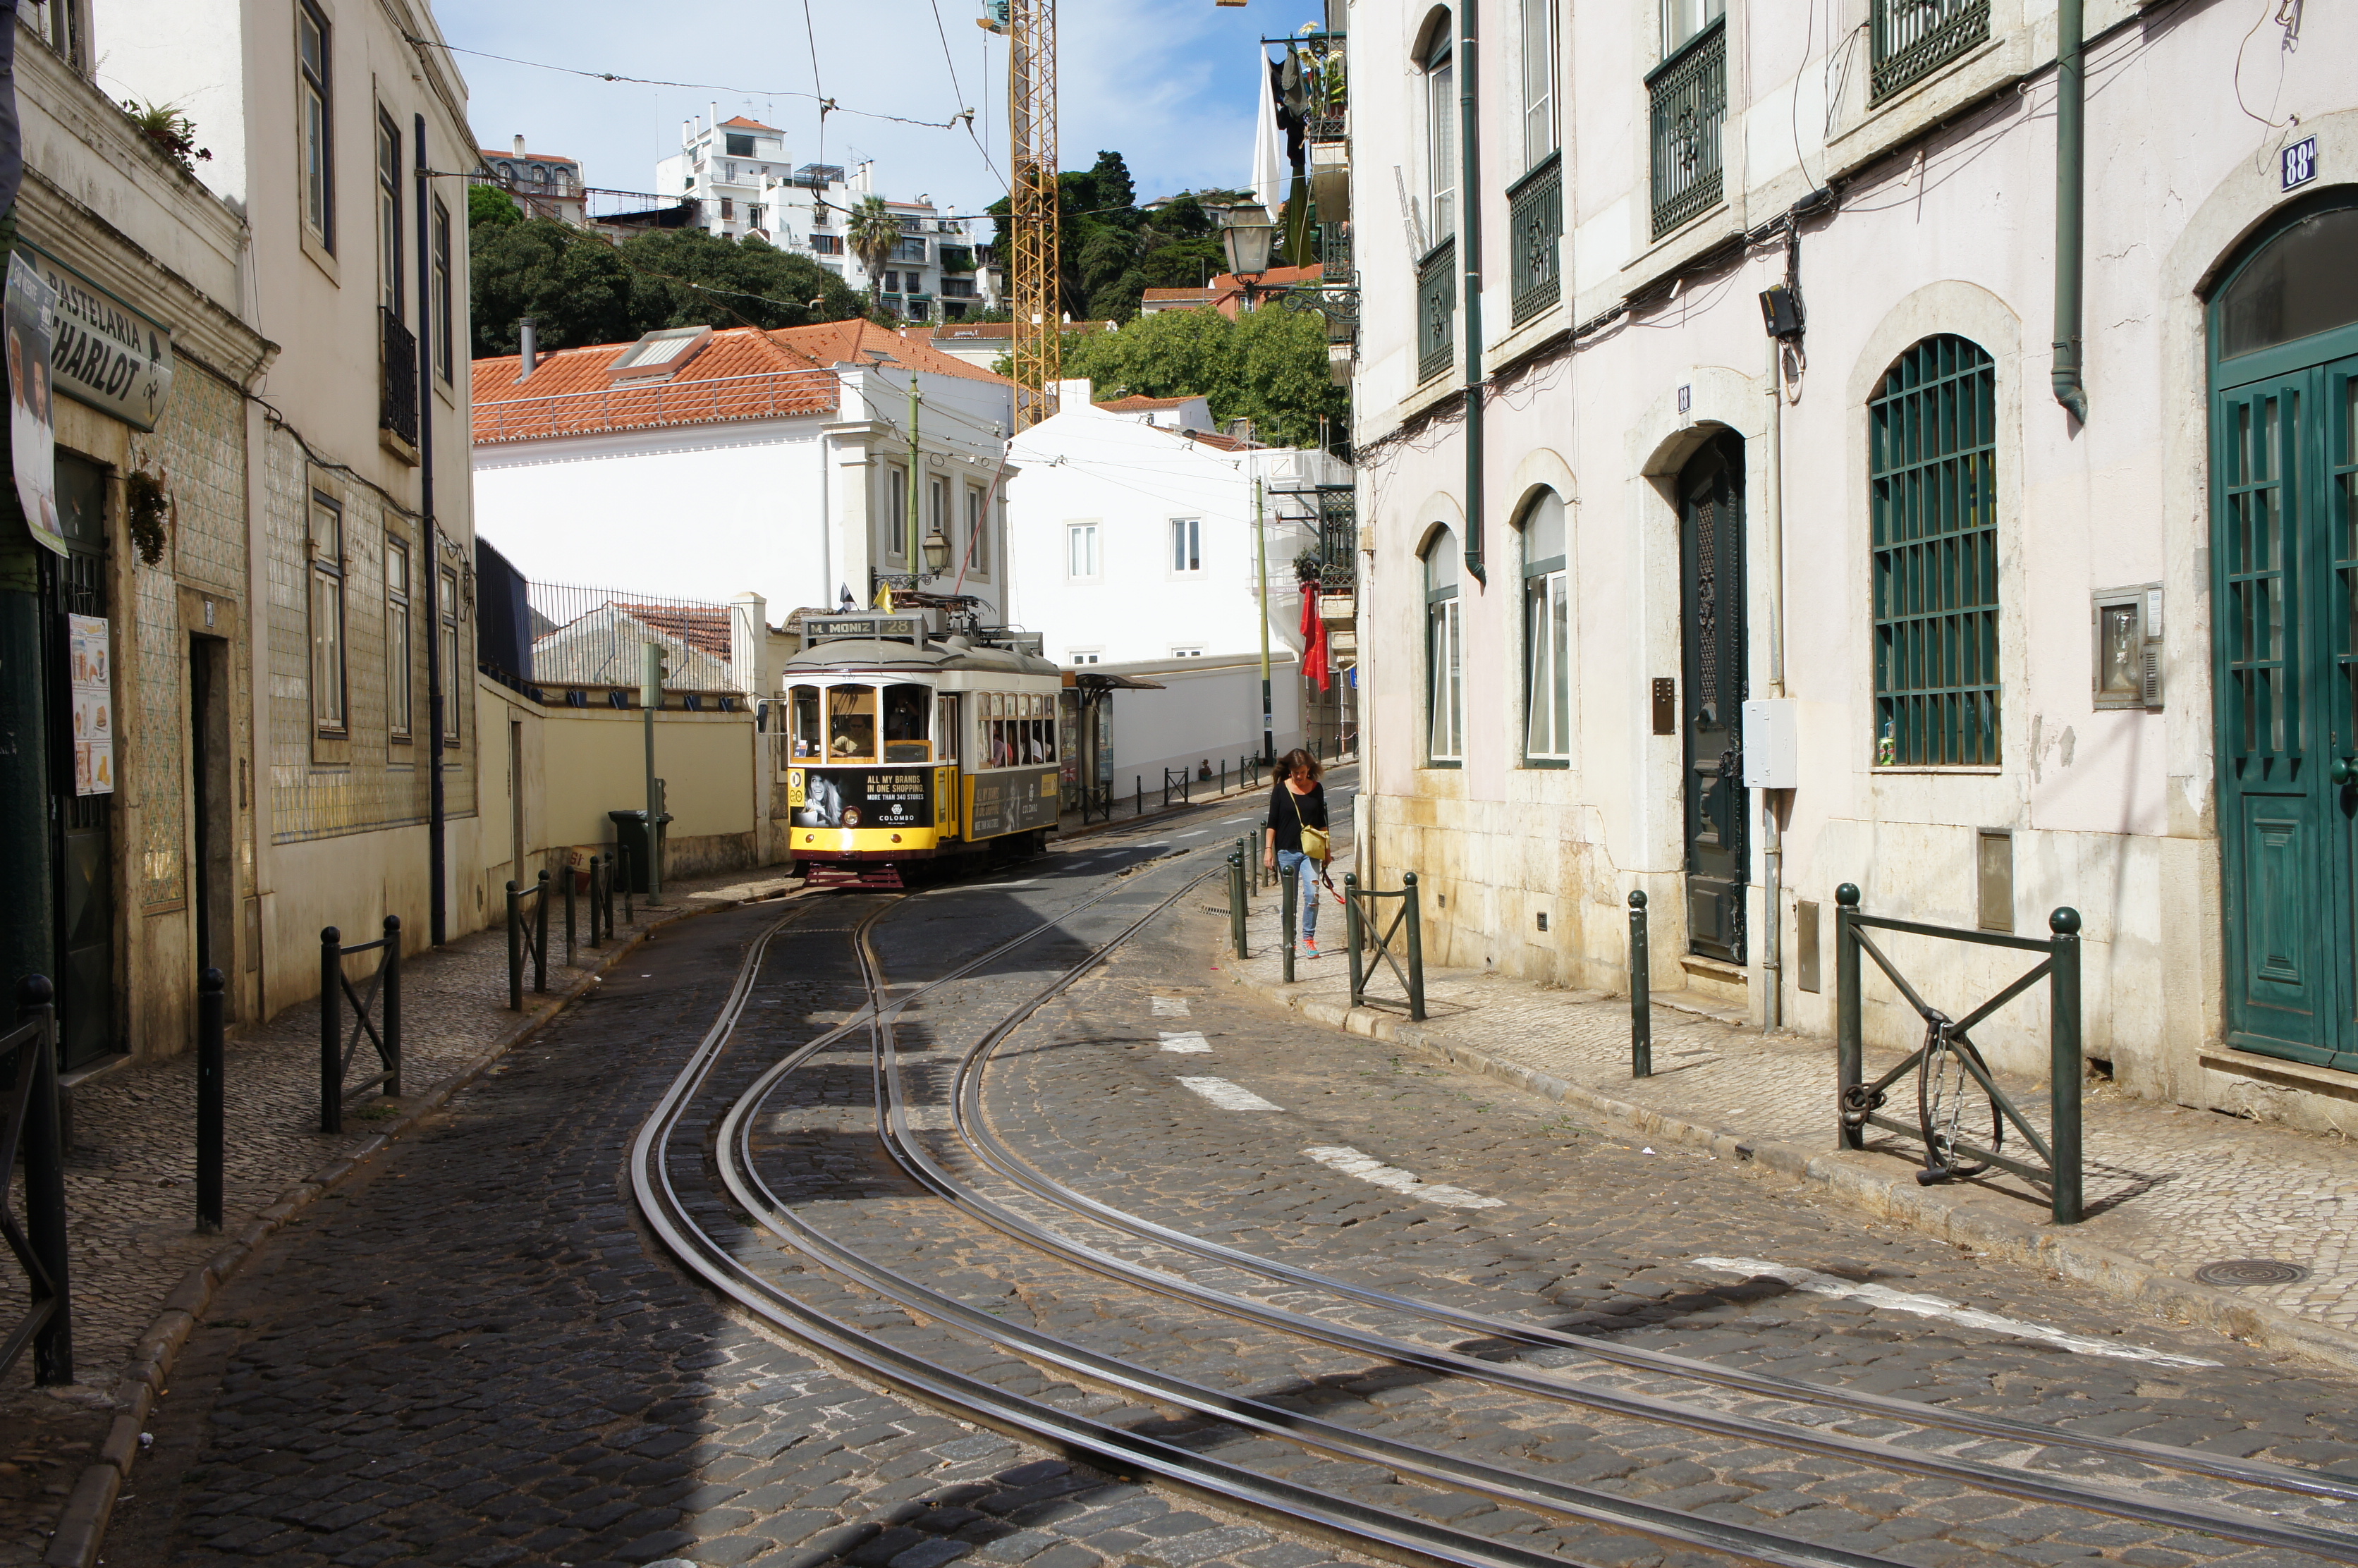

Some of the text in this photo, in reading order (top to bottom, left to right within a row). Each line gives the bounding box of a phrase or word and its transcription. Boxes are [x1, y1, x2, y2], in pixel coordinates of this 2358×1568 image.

[2287, 141, 2314, 185] 88A
[1680, 387, 1688, 410] 88
[829, 623, 871, 633] MONIZ
[887, 620, 908, 632] 28
[867, 775, 921, 783] ALL MY BRANDS
[867, 784, 924, 792] IN ONE SHOPPING.
